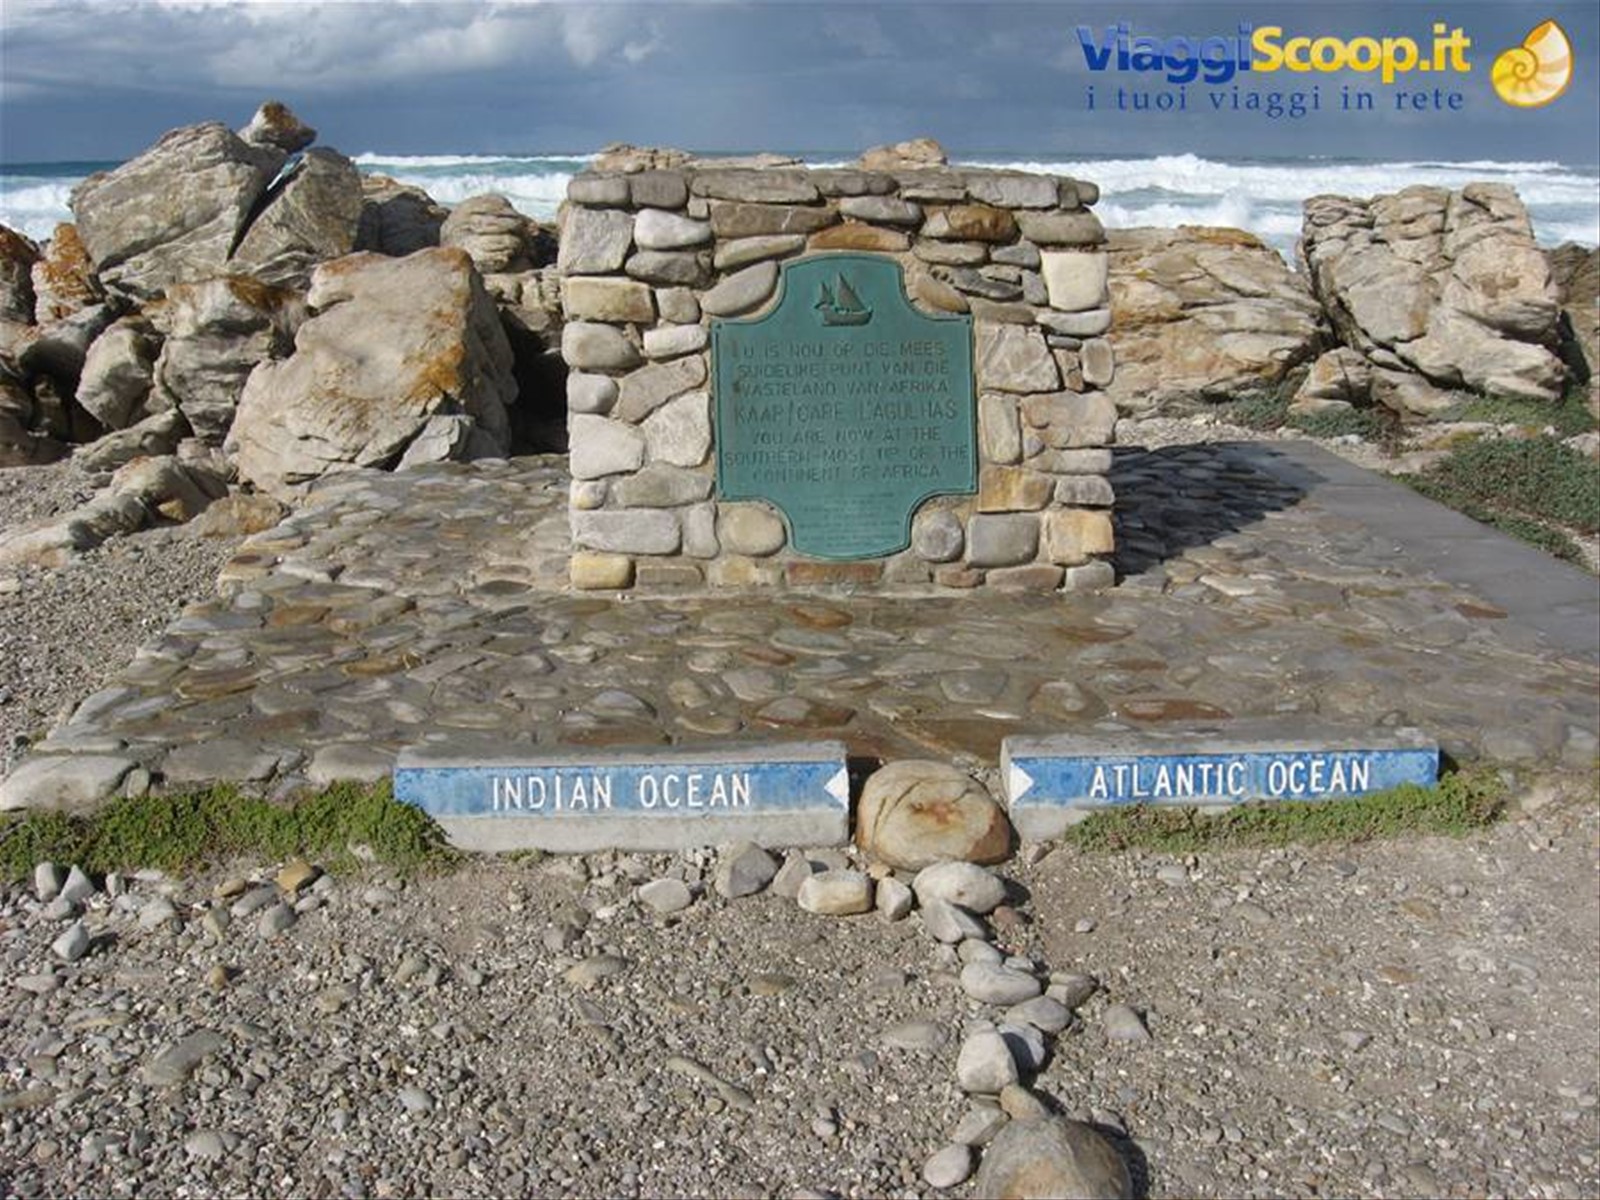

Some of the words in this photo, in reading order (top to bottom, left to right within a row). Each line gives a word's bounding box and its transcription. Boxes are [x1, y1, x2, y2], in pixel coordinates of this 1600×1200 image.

[765, 345, 779, 358] IS
[791, 344, 823, 357] NOU
[834, 343, 852, 357] OP
[864, 342, 889, 357] DIE
[901, 341, 947, 356] MEES
[830, 362, 870, 377] PUNT
[882, 361, 915, 376] VAN
[925, 360, 950, 375] DIE
[740, 381, 837, 396] VASTELAND
[847, 381, 879, 395] VAN
[889, 380, 948, 394] AFRIKA
[752, 430, 783, 445] YOU
[794, 429, 825, 444] ARE
[836, 428, 874, 443] NOW
[882, 428, 902, 441] AT
[912, 427, 941, 441] THE
[941, 445, 968, 460] THE
[882, 464, 940, 479] AFRICA
[1089, 761, 1246, 798] ATLANTIC
[1268, 760, 1370, 795] OCEAN
[492, 775, 611, 810] INDIAN
[639, 774, 752, 809] OCEAN
